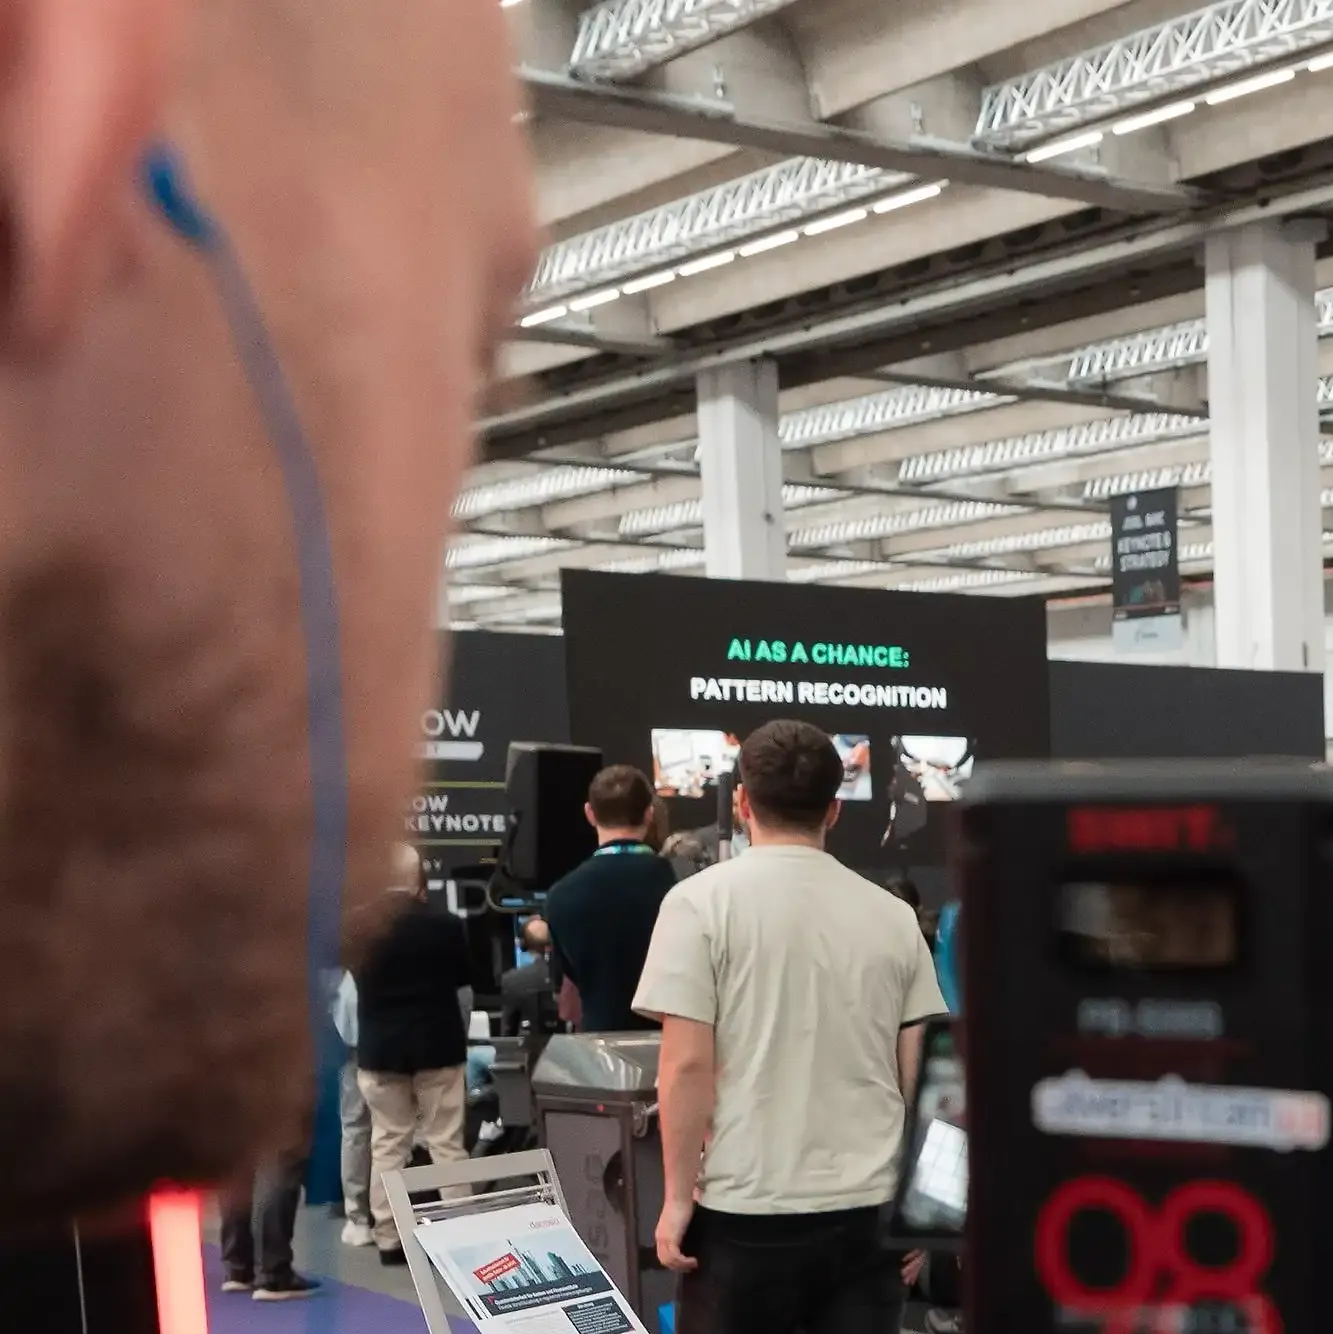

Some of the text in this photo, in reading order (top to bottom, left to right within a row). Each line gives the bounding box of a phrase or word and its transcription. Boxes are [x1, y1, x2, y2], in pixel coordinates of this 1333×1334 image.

[727, 638, 910, 668] AI AS A CHANCE:
[690, 677, 948, 709] PATTERN RECOGNITION
[405, 814, 507, 832] KEYNOTE
